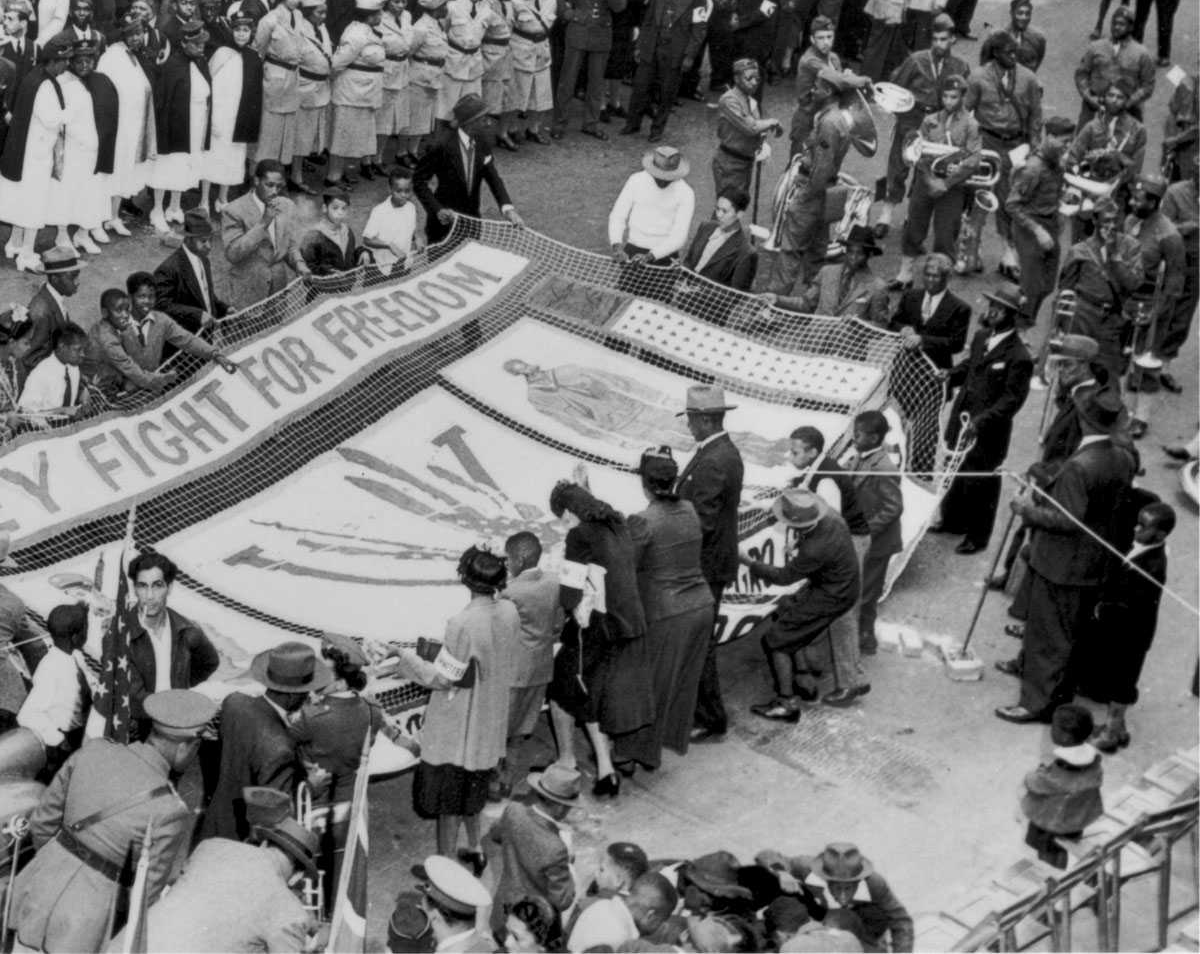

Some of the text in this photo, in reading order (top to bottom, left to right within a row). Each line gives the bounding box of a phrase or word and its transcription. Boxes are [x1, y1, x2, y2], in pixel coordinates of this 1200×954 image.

[79, 378, 250, 492] FIGHT
[237, 336, 335, 410] FOR
[312, 262, 502, 360] FREEDOM
